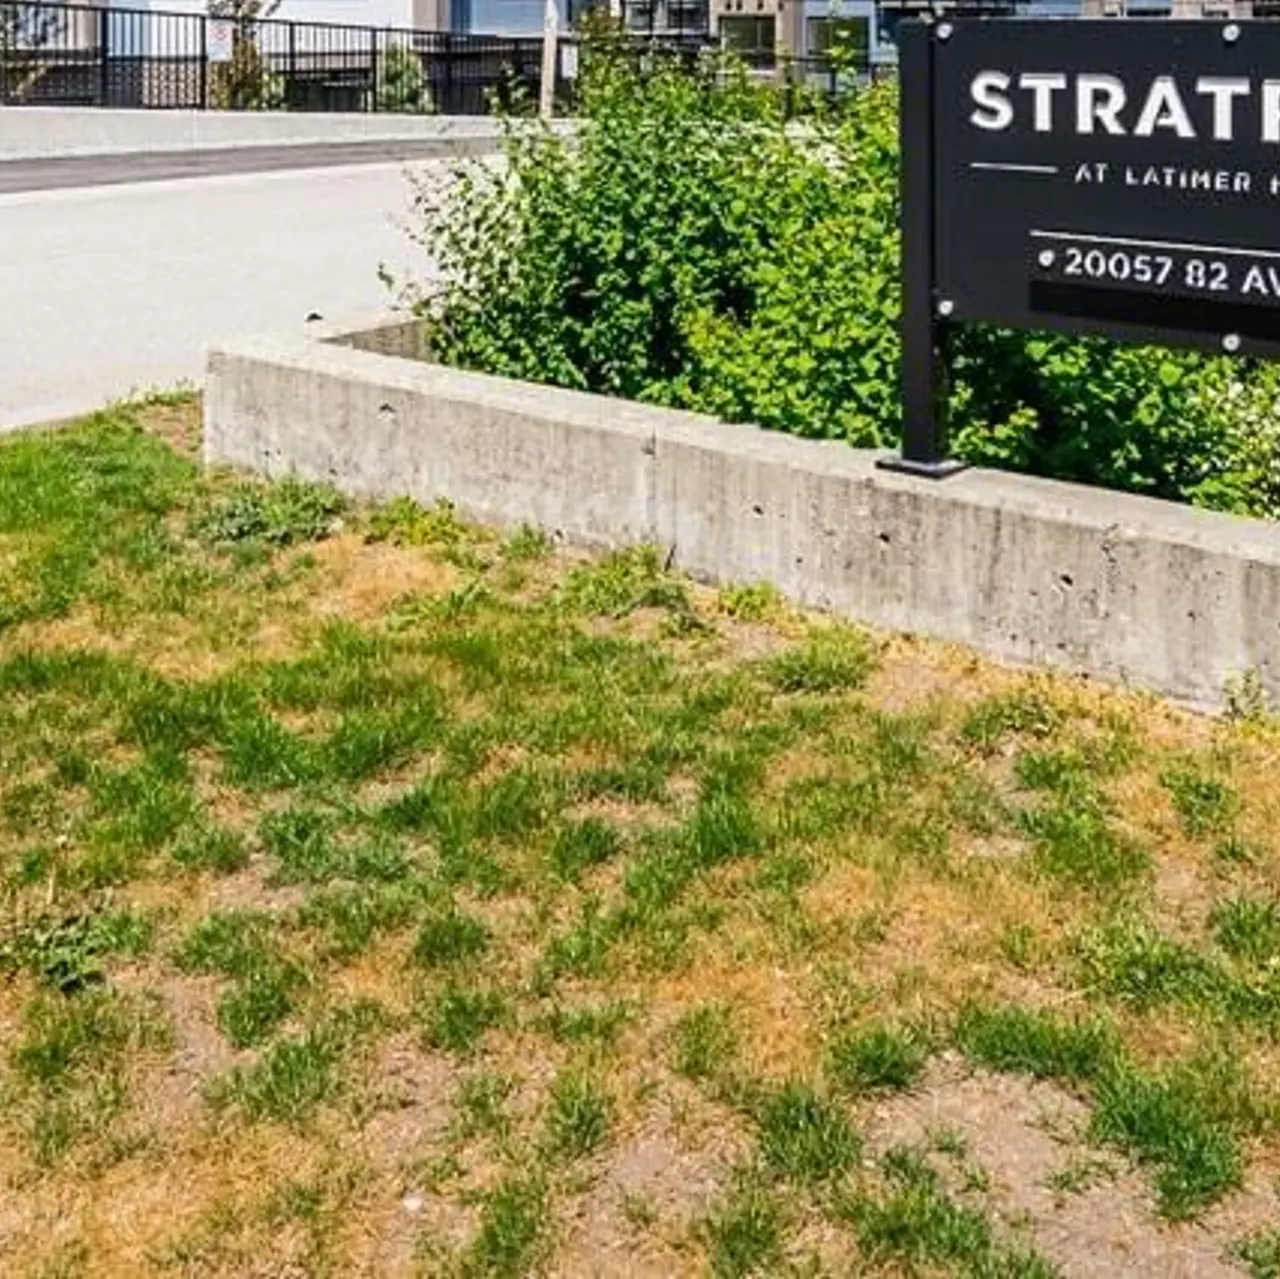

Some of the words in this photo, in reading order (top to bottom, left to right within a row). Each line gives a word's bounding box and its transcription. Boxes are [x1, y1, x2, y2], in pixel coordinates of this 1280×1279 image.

[1073, 163, 1109, 183] AT
[1125, 166, 1251, 193] LATIMER
[1063, 246, 1173, 286] 20057
[1183, 258, 1230, 292] 82
